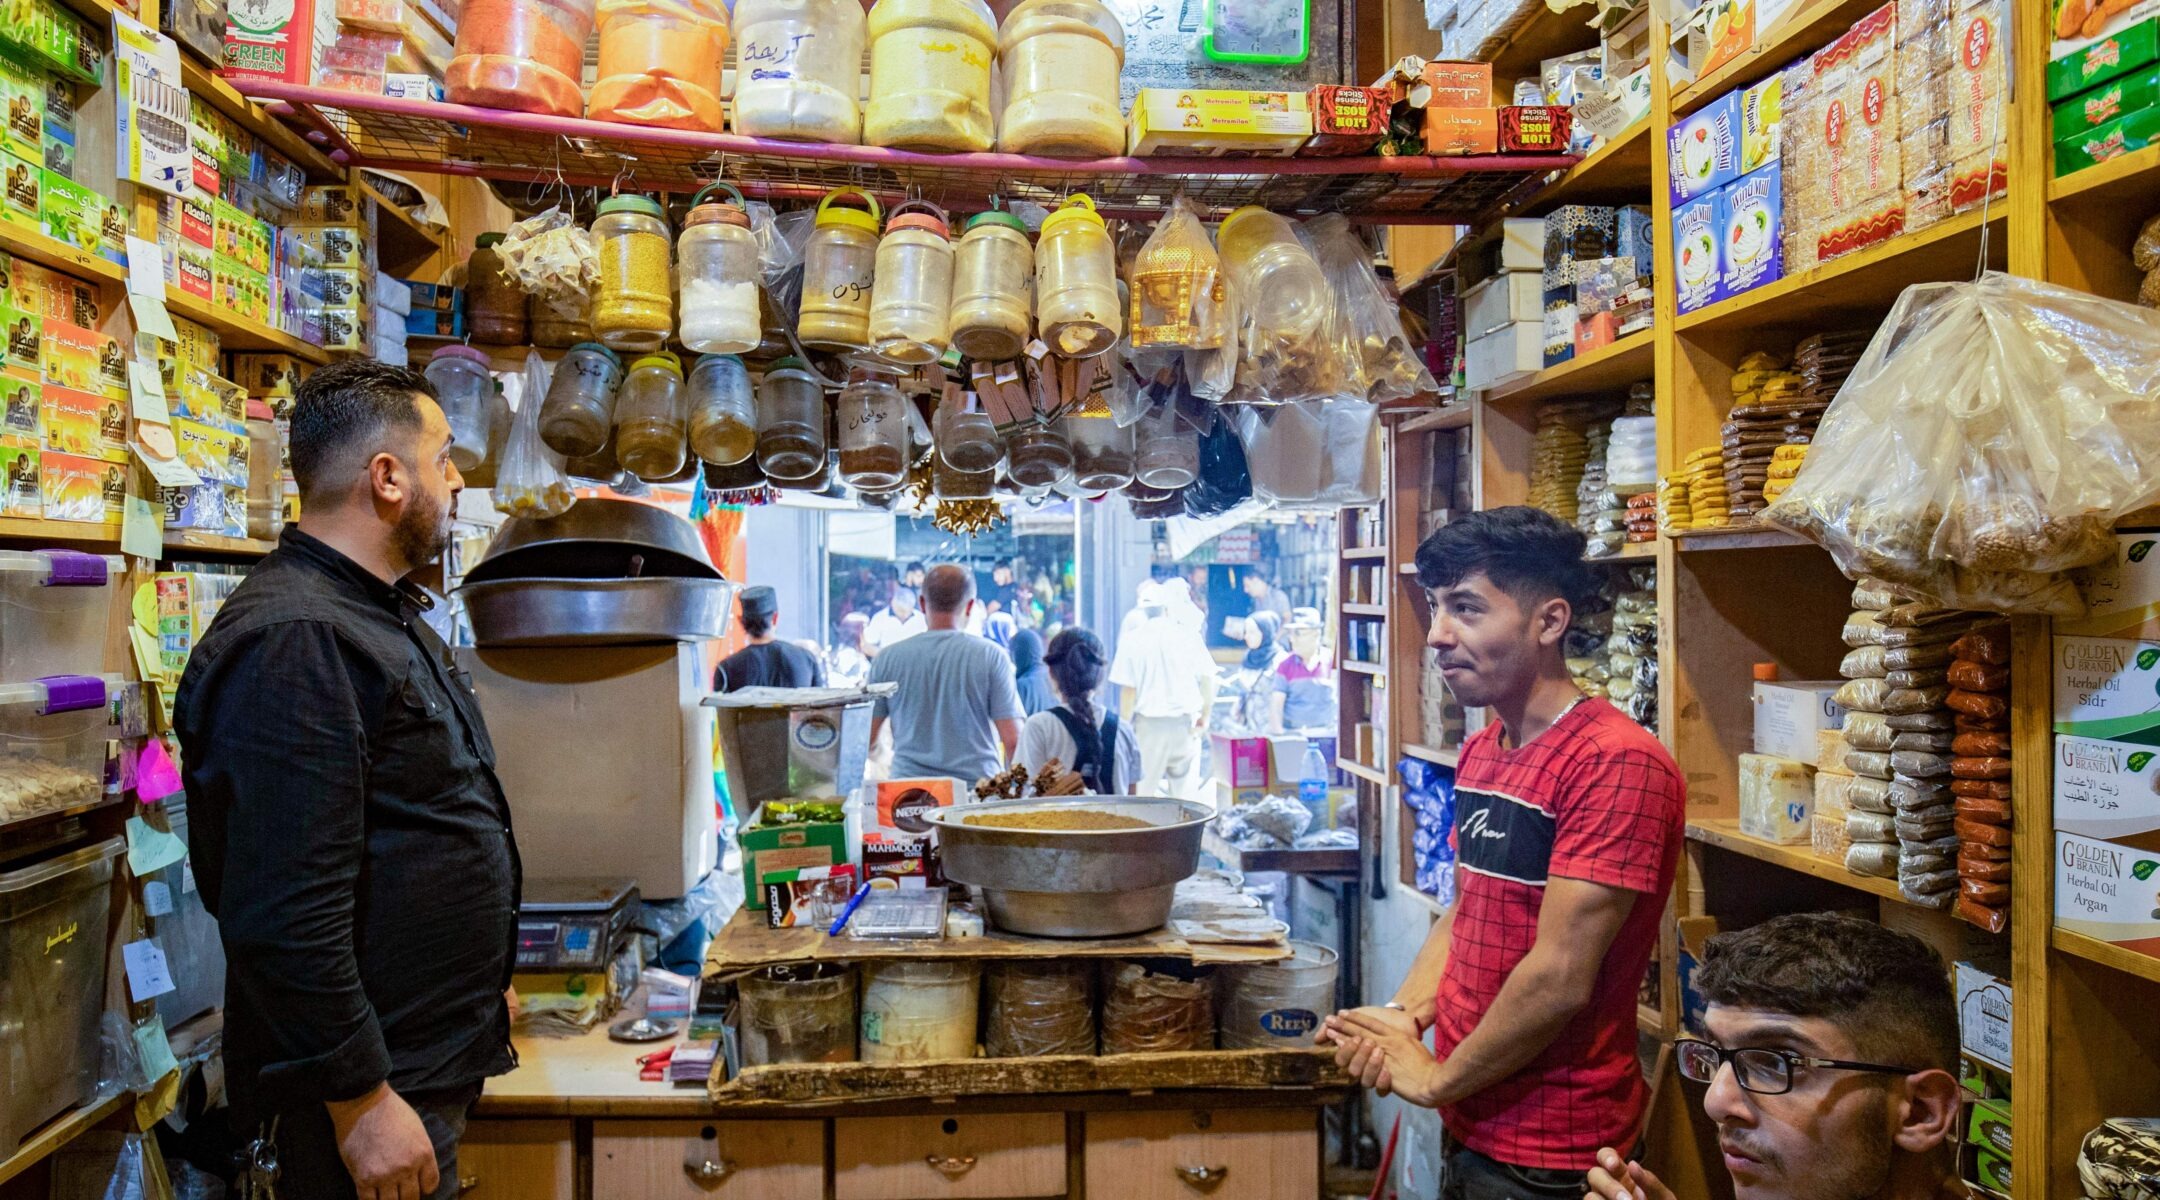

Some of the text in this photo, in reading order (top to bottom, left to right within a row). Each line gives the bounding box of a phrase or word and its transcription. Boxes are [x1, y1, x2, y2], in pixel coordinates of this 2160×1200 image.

[1289, 7, 1298, 18] 3
[224, 43, 285, 63] GREEN
[224, 57, 285, 73] CARDAMOM
[1335, 97, 1367, 105] Incense
[1338, 90, 1364, 98] Sticks
[1336, 106, 1367, 116] ROSE
[1971, 73, 1983, 143] Petit Beurre
[10, 106, 41, 131] العطار
[1336, 117, 1367, 128] LION
[1520, 123, 1550, 132] ROSE
[1521, 134, 1550, 144] LION
[1715, 109, 1734, 171] Wind Mill
[1870, 131, 1880, 190] Petit Beurre
[8, 176, 38, 199] العطار
[1731, 175, 1770, 212] Wind Mill
[1831, 174, 1840, 208] Beurre
[184, 203, 206, 224] العطار
[1677, 203, 1712, 236] Wind Mill
[181, 259, 202, 279] العطار
[10, 331, 40, 349] العطار
[101, 354, 126, 370] العطار
[101, 416, 126, 433] العطار
[103, 479, 126, 494] العطار
[2063, 643, 2126, 672] GOLDEN
[2078, 661, 2112, 673] BRAND
[2066, 675, 2120, 691] Herbal Oil
[2079, 693, 2107, 707] Sidr
[2062, 741, 2122, 774] GOLDEN
[2075, 759, 2107, 773] BRAND
[2100, 782, 2119, 796] زيت
[2063, 789, 2119, 810] جوزة الطيب
[895, 806, 928, 818] NESCA
[867, 844, 922, 853] MAHMOOD
[2062, 840, 2123, 880] GOLDEN
[2076, 860, 2108, 877] BRAND
[2066, 873, 2117, 897] Herbal Oil
[2073, 892, 2108, 913] Argan
[1981, 994, 2009, 1020] GOLDEN
